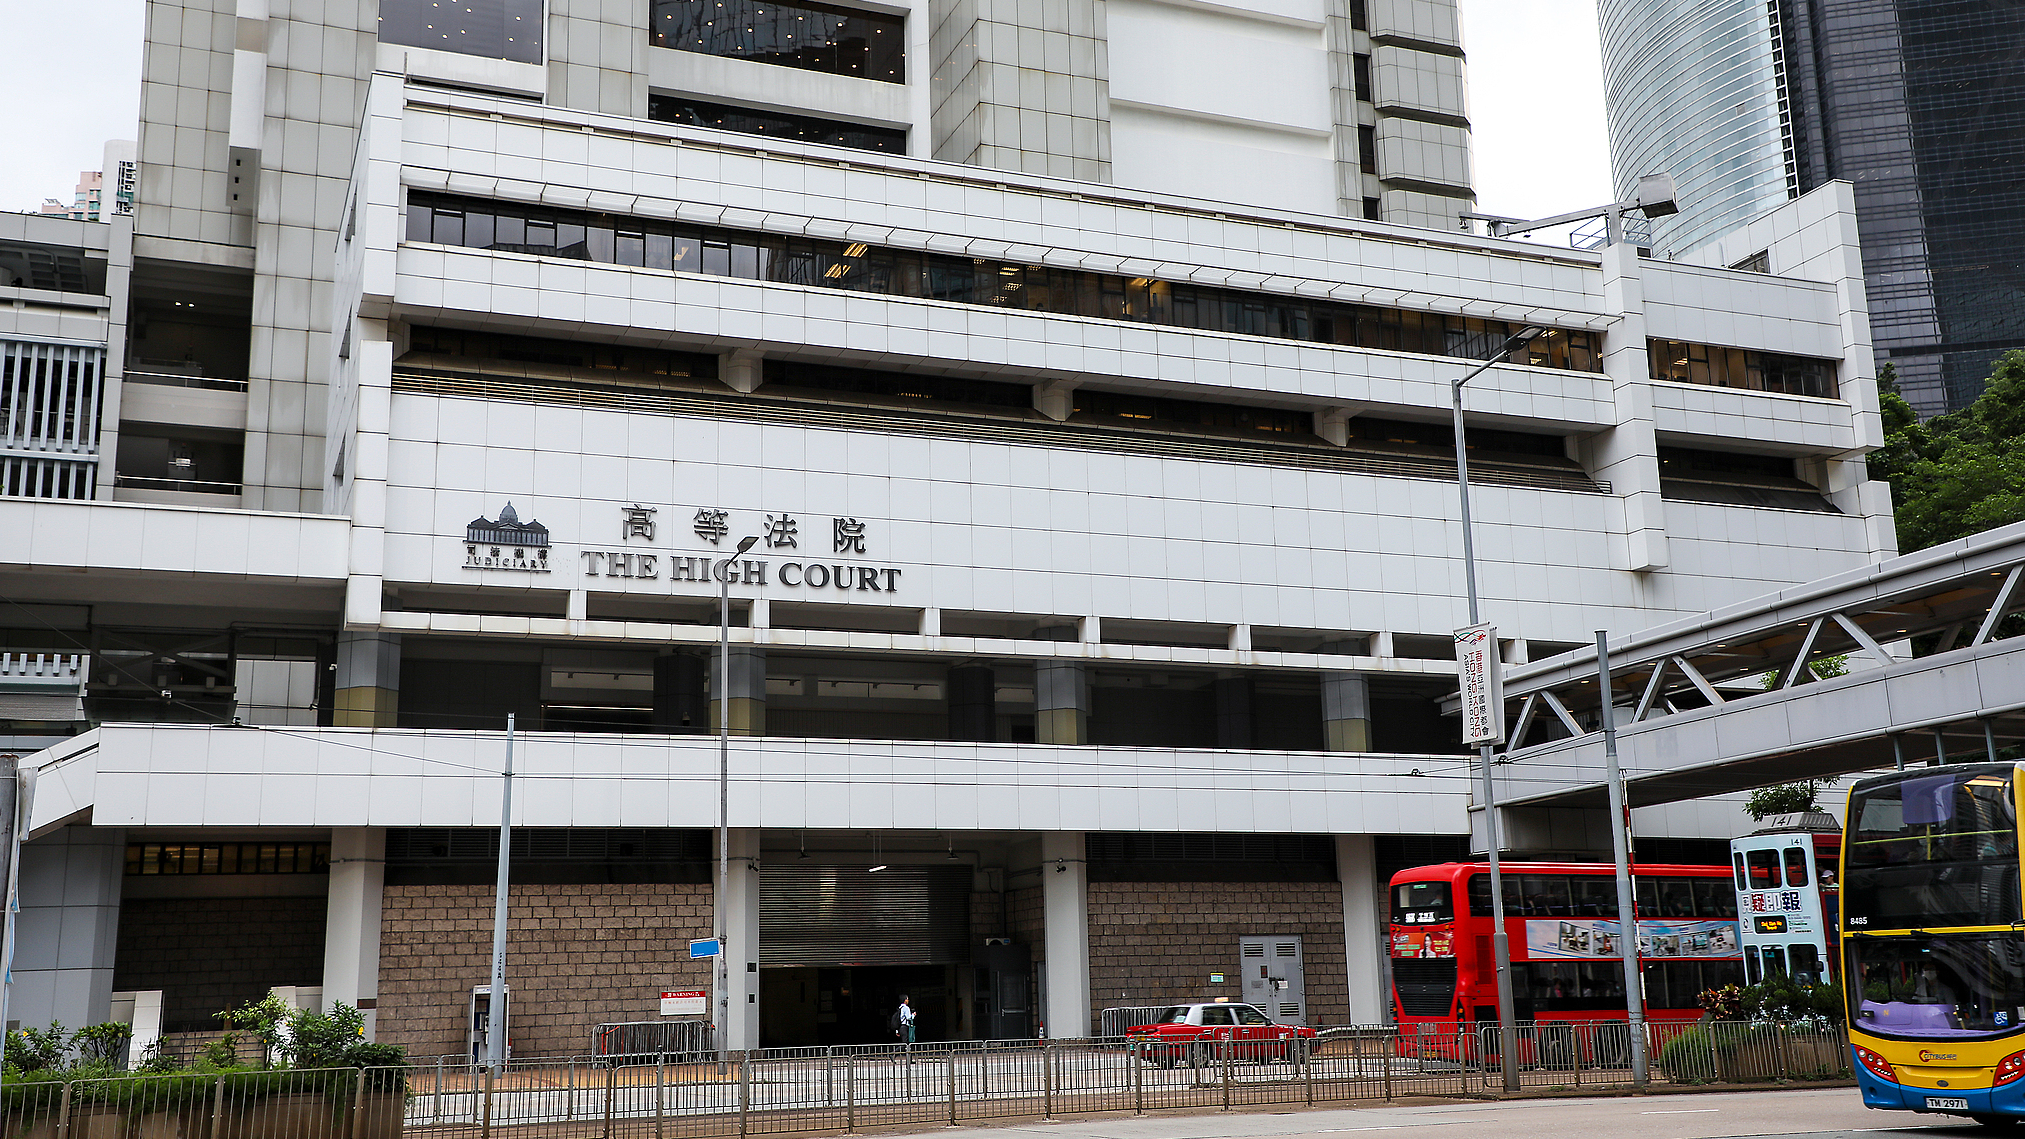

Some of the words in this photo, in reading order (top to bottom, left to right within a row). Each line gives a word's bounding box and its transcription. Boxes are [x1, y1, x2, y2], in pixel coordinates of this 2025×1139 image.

[621, 504, 867, 554] 高等法院
[466, 556, 548, 569] JUDICIARY
[580, 550, 659, 580] THE
[669, 556, 769, 586] HIGH
[778, 562, 902, 593] COURT
[1469, 652, 1478, 693] HONG
[1473, 696, 1482, 738] KONG
[1771, 815, 1792, 827] 141
[1741, 890, 1802, 914] 見疑即報
[1850, 916, 1868, 925] 8485
[1928, 1098, 1940, 1107] TM
[1943, 1099, 1964, 1108] 2971
